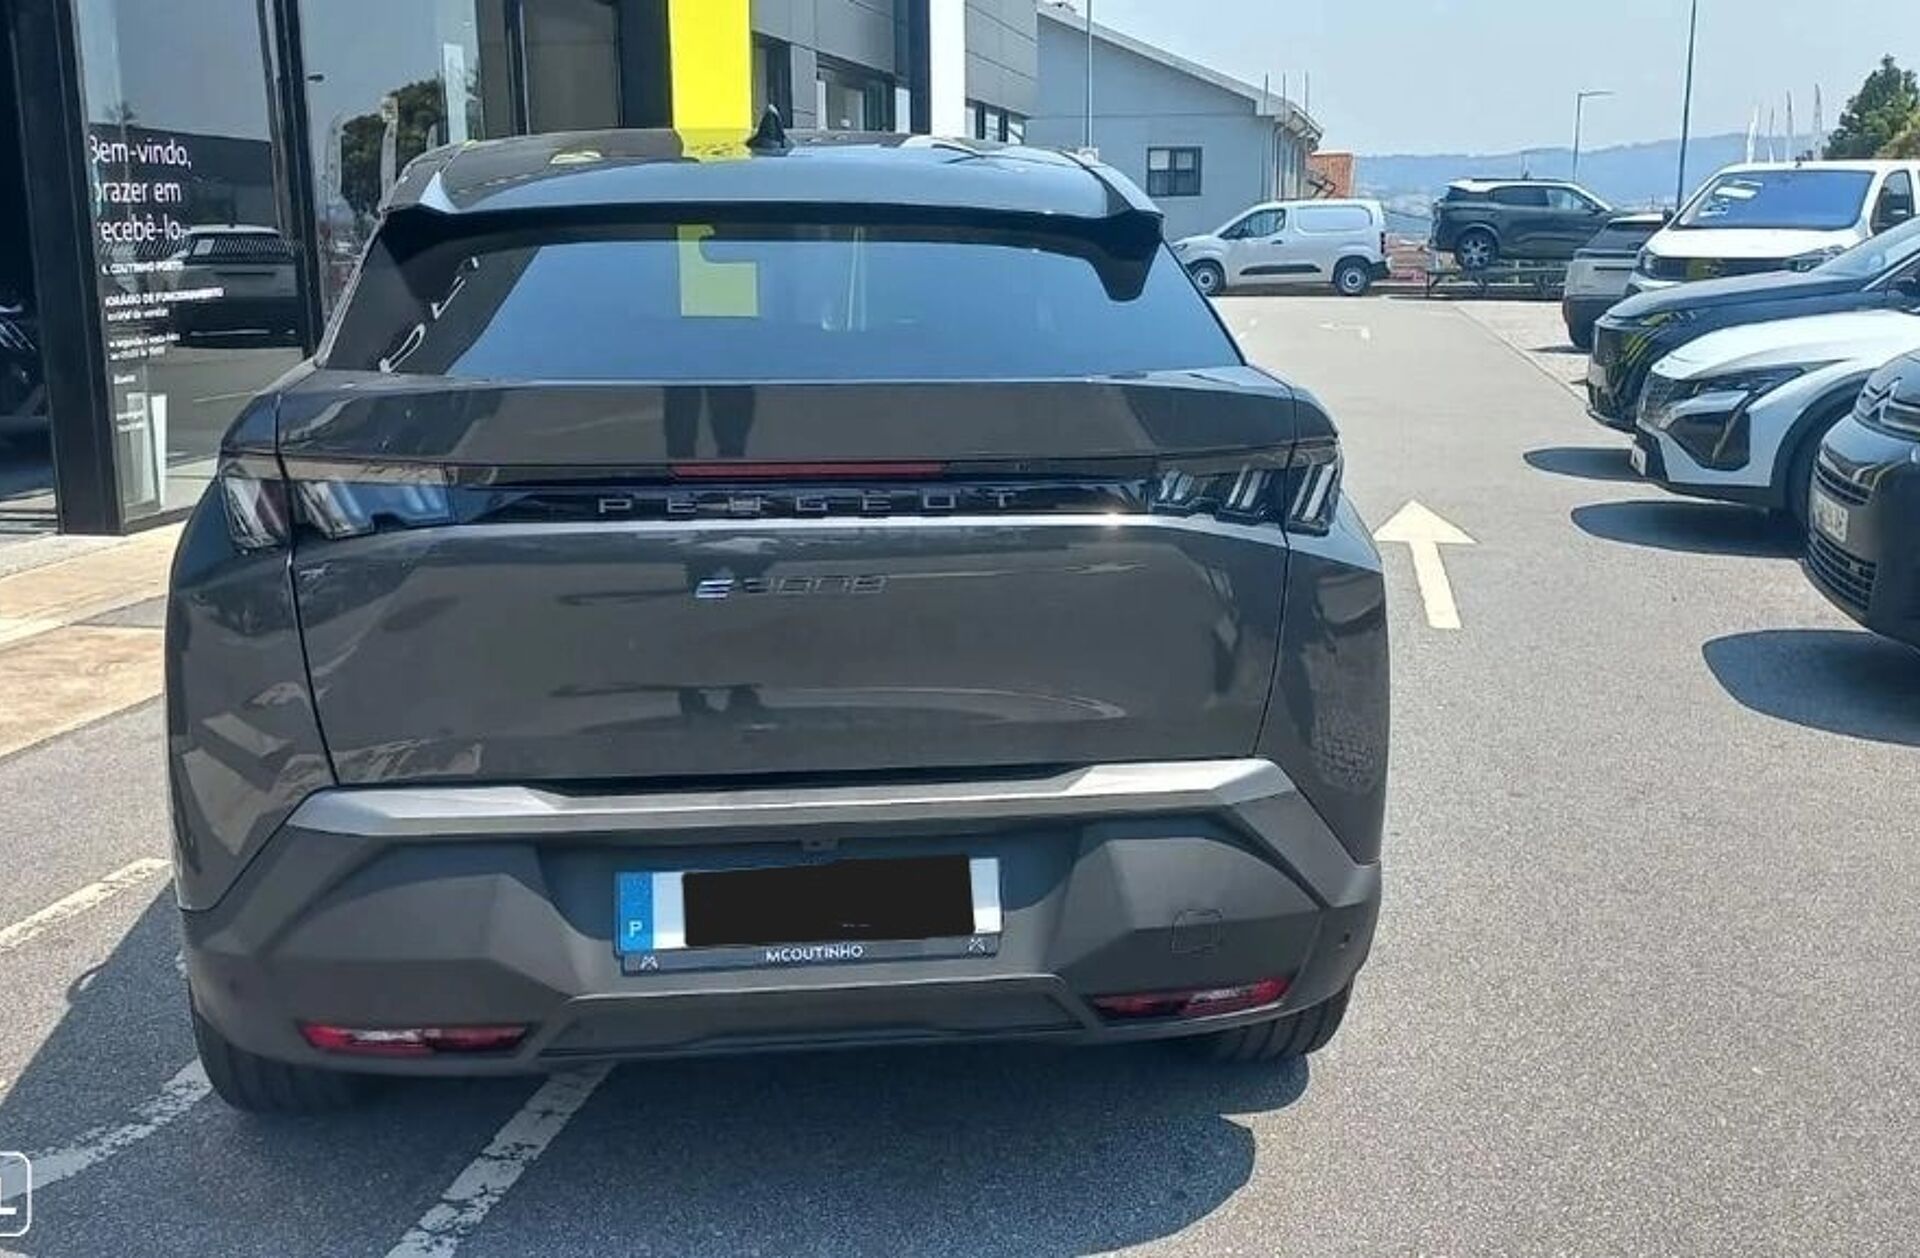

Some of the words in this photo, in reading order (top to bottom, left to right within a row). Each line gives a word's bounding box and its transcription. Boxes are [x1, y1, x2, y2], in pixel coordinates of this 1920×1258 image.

[89, 134, 192, 170] Bem-vindo,
[154, 182, 182, 203] em
[97, 213, 186, 241] ecebê-lo.
[599, 488, 1015, 514] PEUGEOT
[629, 921, 643, 938] P
